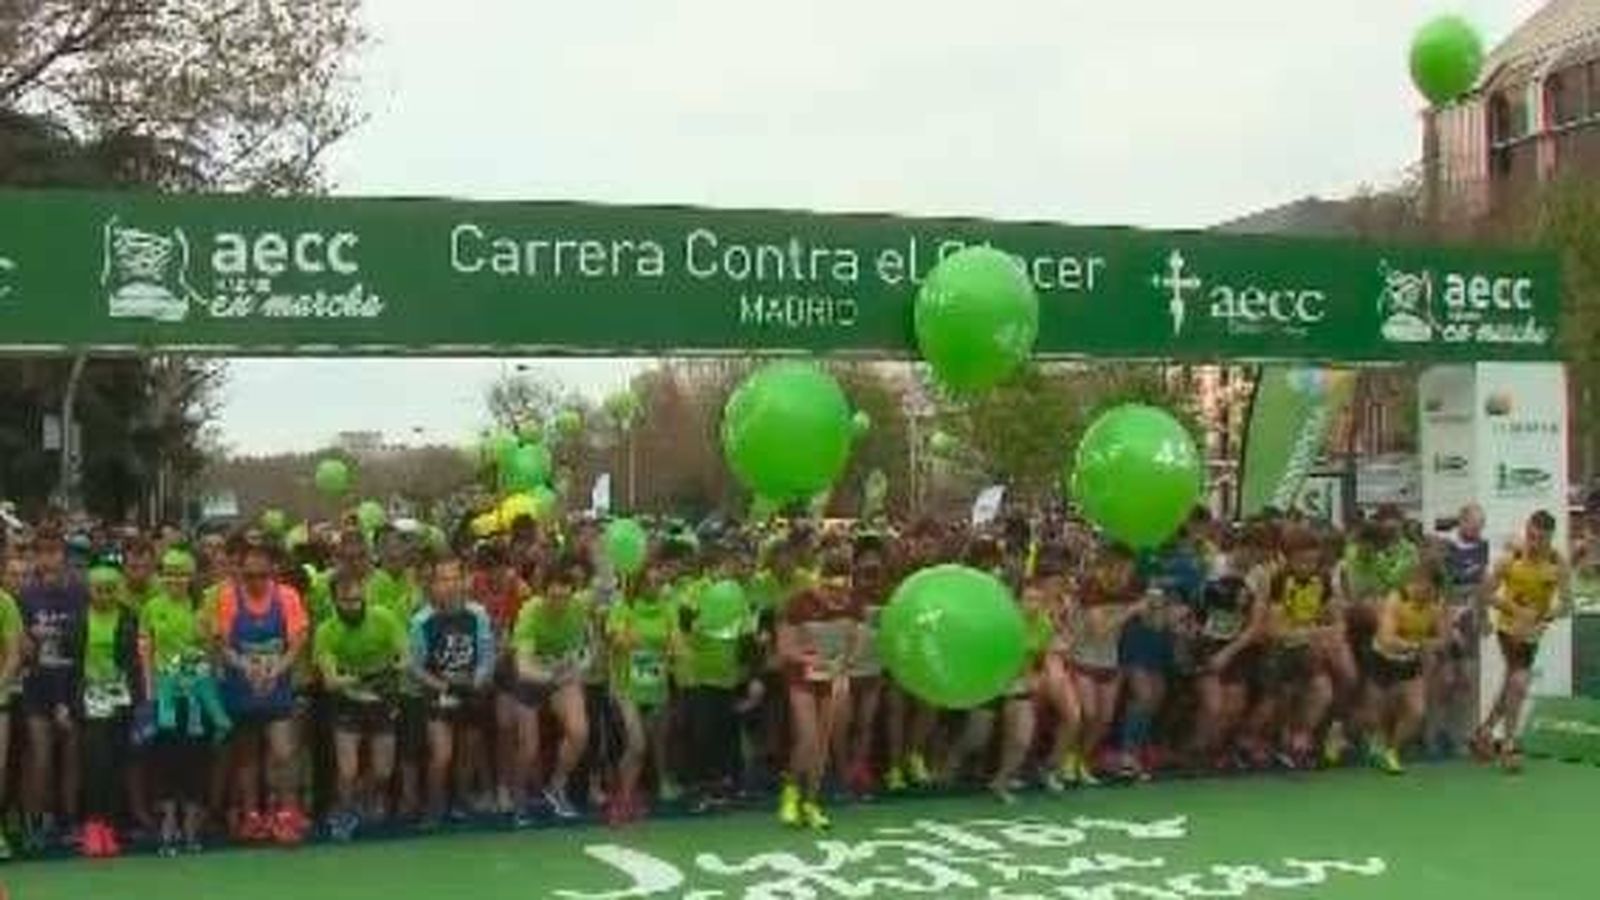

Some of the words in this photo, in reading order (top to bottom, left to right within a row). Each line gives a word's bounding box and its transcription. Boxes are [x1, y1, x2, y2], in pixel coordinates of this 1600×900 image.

[211, 231, 360, 274] aecc
[450, 223, 665, 276] Carrera
[686, 228, 859, 283] Contra
[876, 237, 925, 285] el
[937, 240, 1107, 291] cer
[740, 294, 859, 326] MADRID
[1209, 285, 1326, 322] aecc
[1445, 272, 1532, 310] aecc
